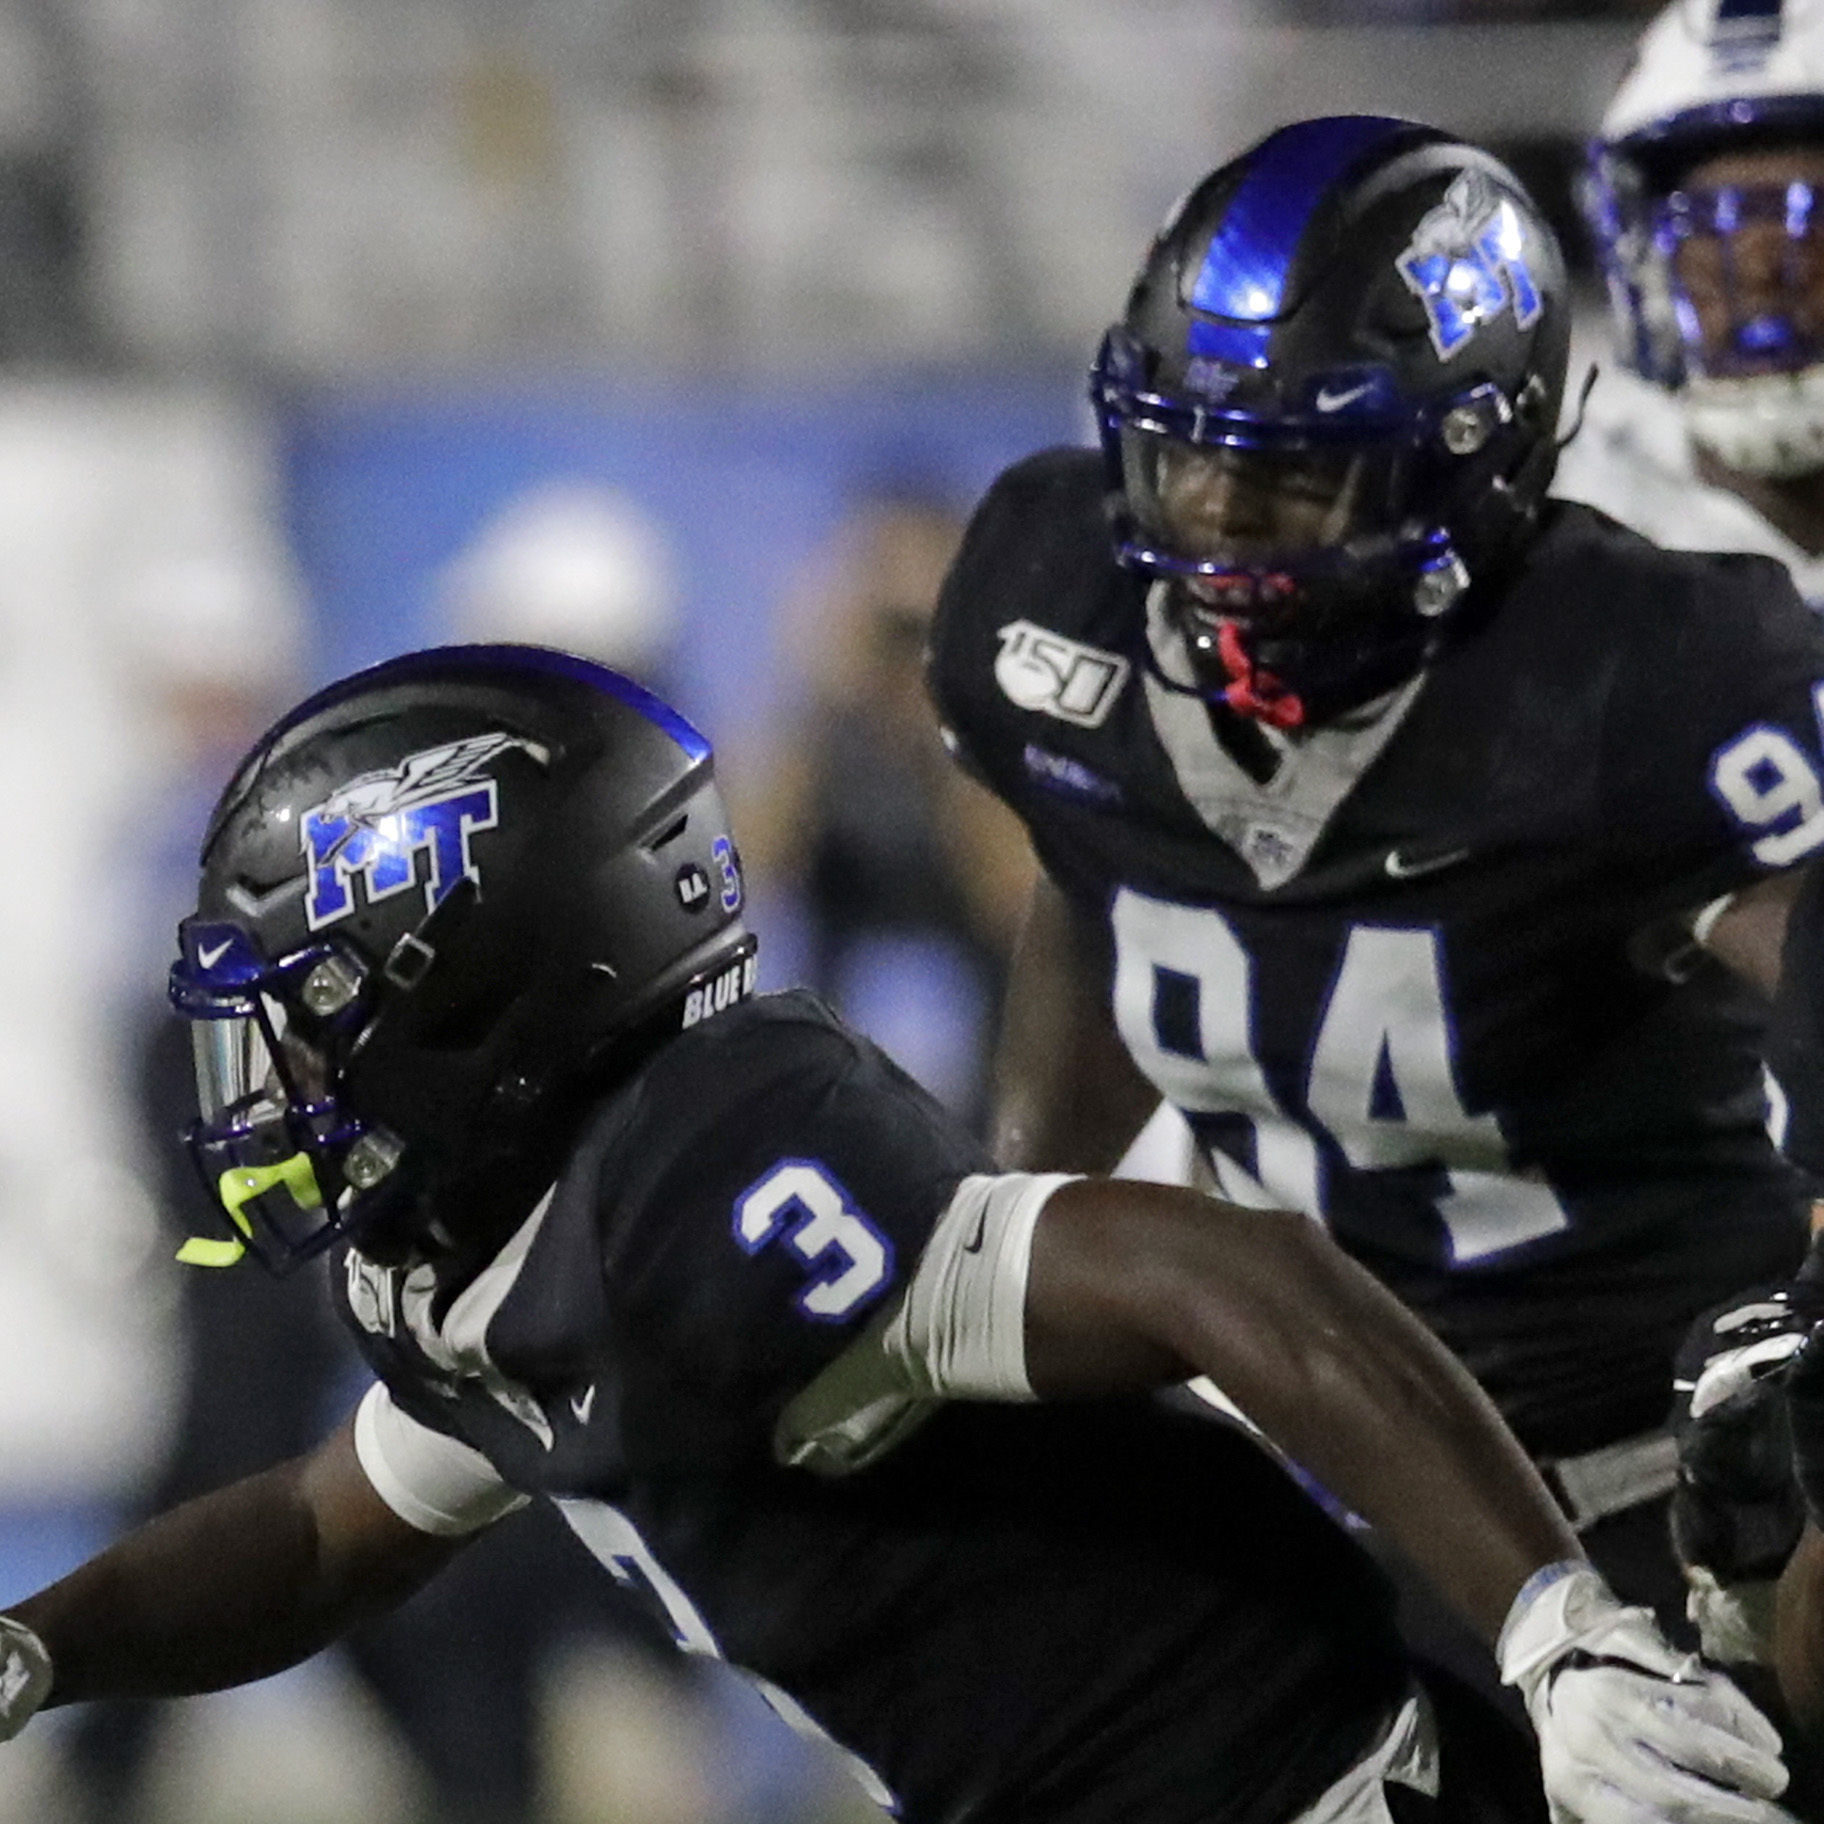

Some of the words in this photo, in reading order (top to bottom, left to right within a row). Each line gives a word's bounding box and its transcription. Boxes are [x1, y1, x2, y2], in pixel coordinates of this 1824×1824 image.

[1006, 628, 1119, 716] 150
[1707, 676, 1824, 868] 9
[712, 834, 741, 914] 3
[682, 963, 742, 1030] BLUE
[733, 1157, 894, 1322] 3
